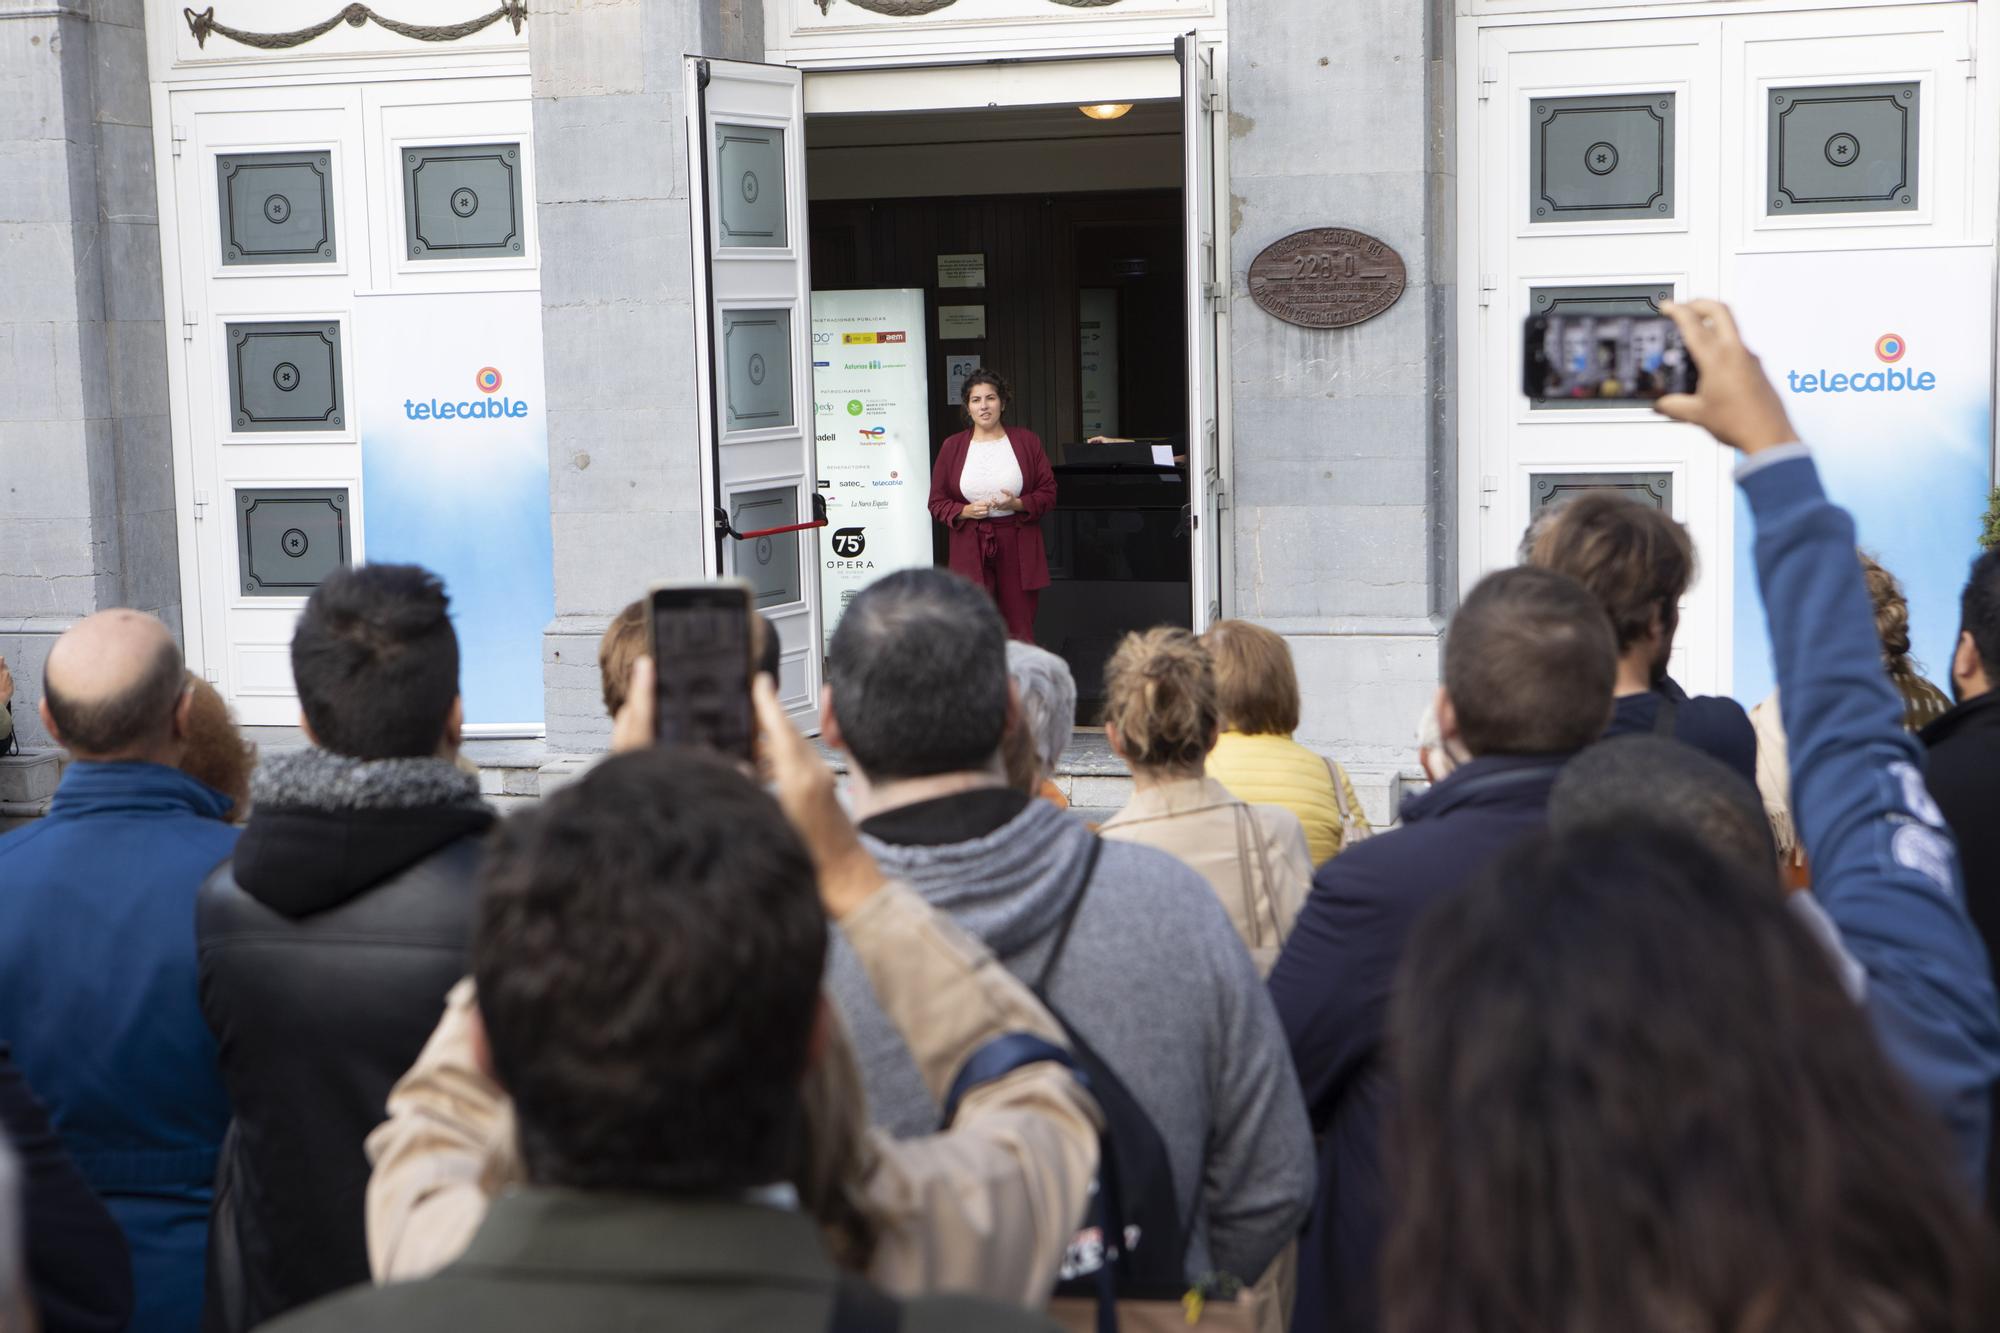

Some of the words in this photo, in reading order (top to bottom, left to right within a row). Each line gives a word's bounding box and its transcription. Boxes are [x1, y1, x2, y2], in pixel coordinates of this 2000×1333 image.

[1323, 231, 1362, 249] GENERAL
[1787, 367, 1936, 393] telecable
[403, 397, 528, 420] telecable
[819, 401, 834, 412] edp
[872, 479, 903, 487] telecable
